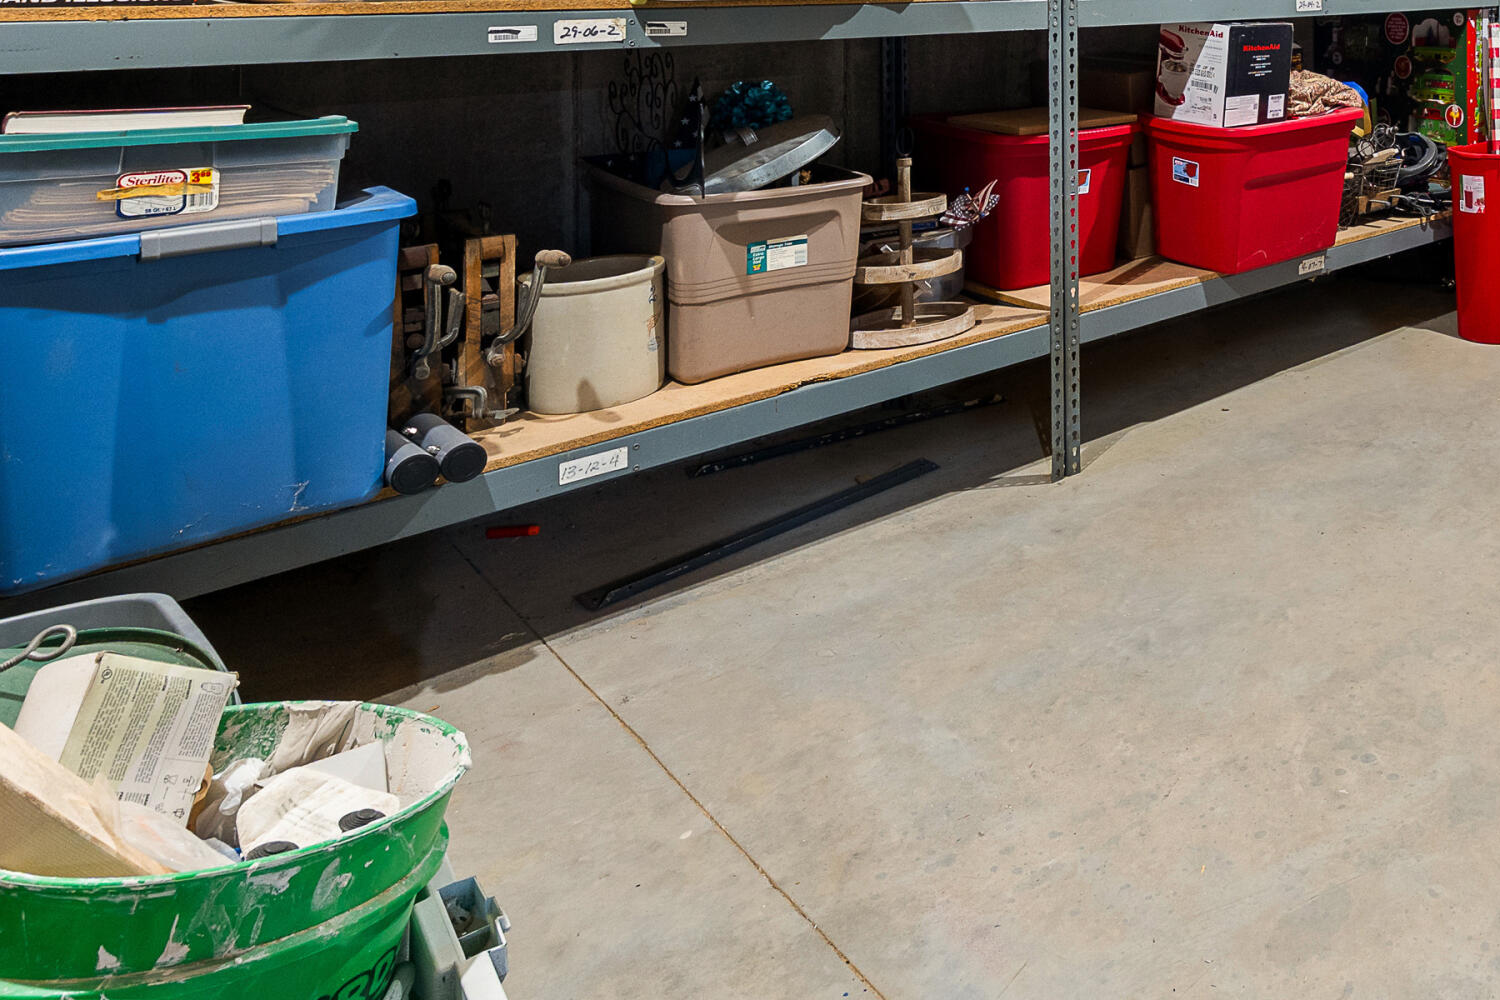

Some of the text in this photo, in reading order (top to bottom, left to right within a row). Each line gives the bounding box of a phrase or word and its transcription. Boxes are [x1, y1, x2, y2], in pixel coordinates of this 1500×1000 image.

[560, 24, 621, 40] 29-06-2
[1178, 24, 1224, 39] KitchenAid
[1243, 43, 1281, 52] KitchenAid
[126, 174, 176, 187] Sterilite
[561, 454, 619, 481] 13-12-4
